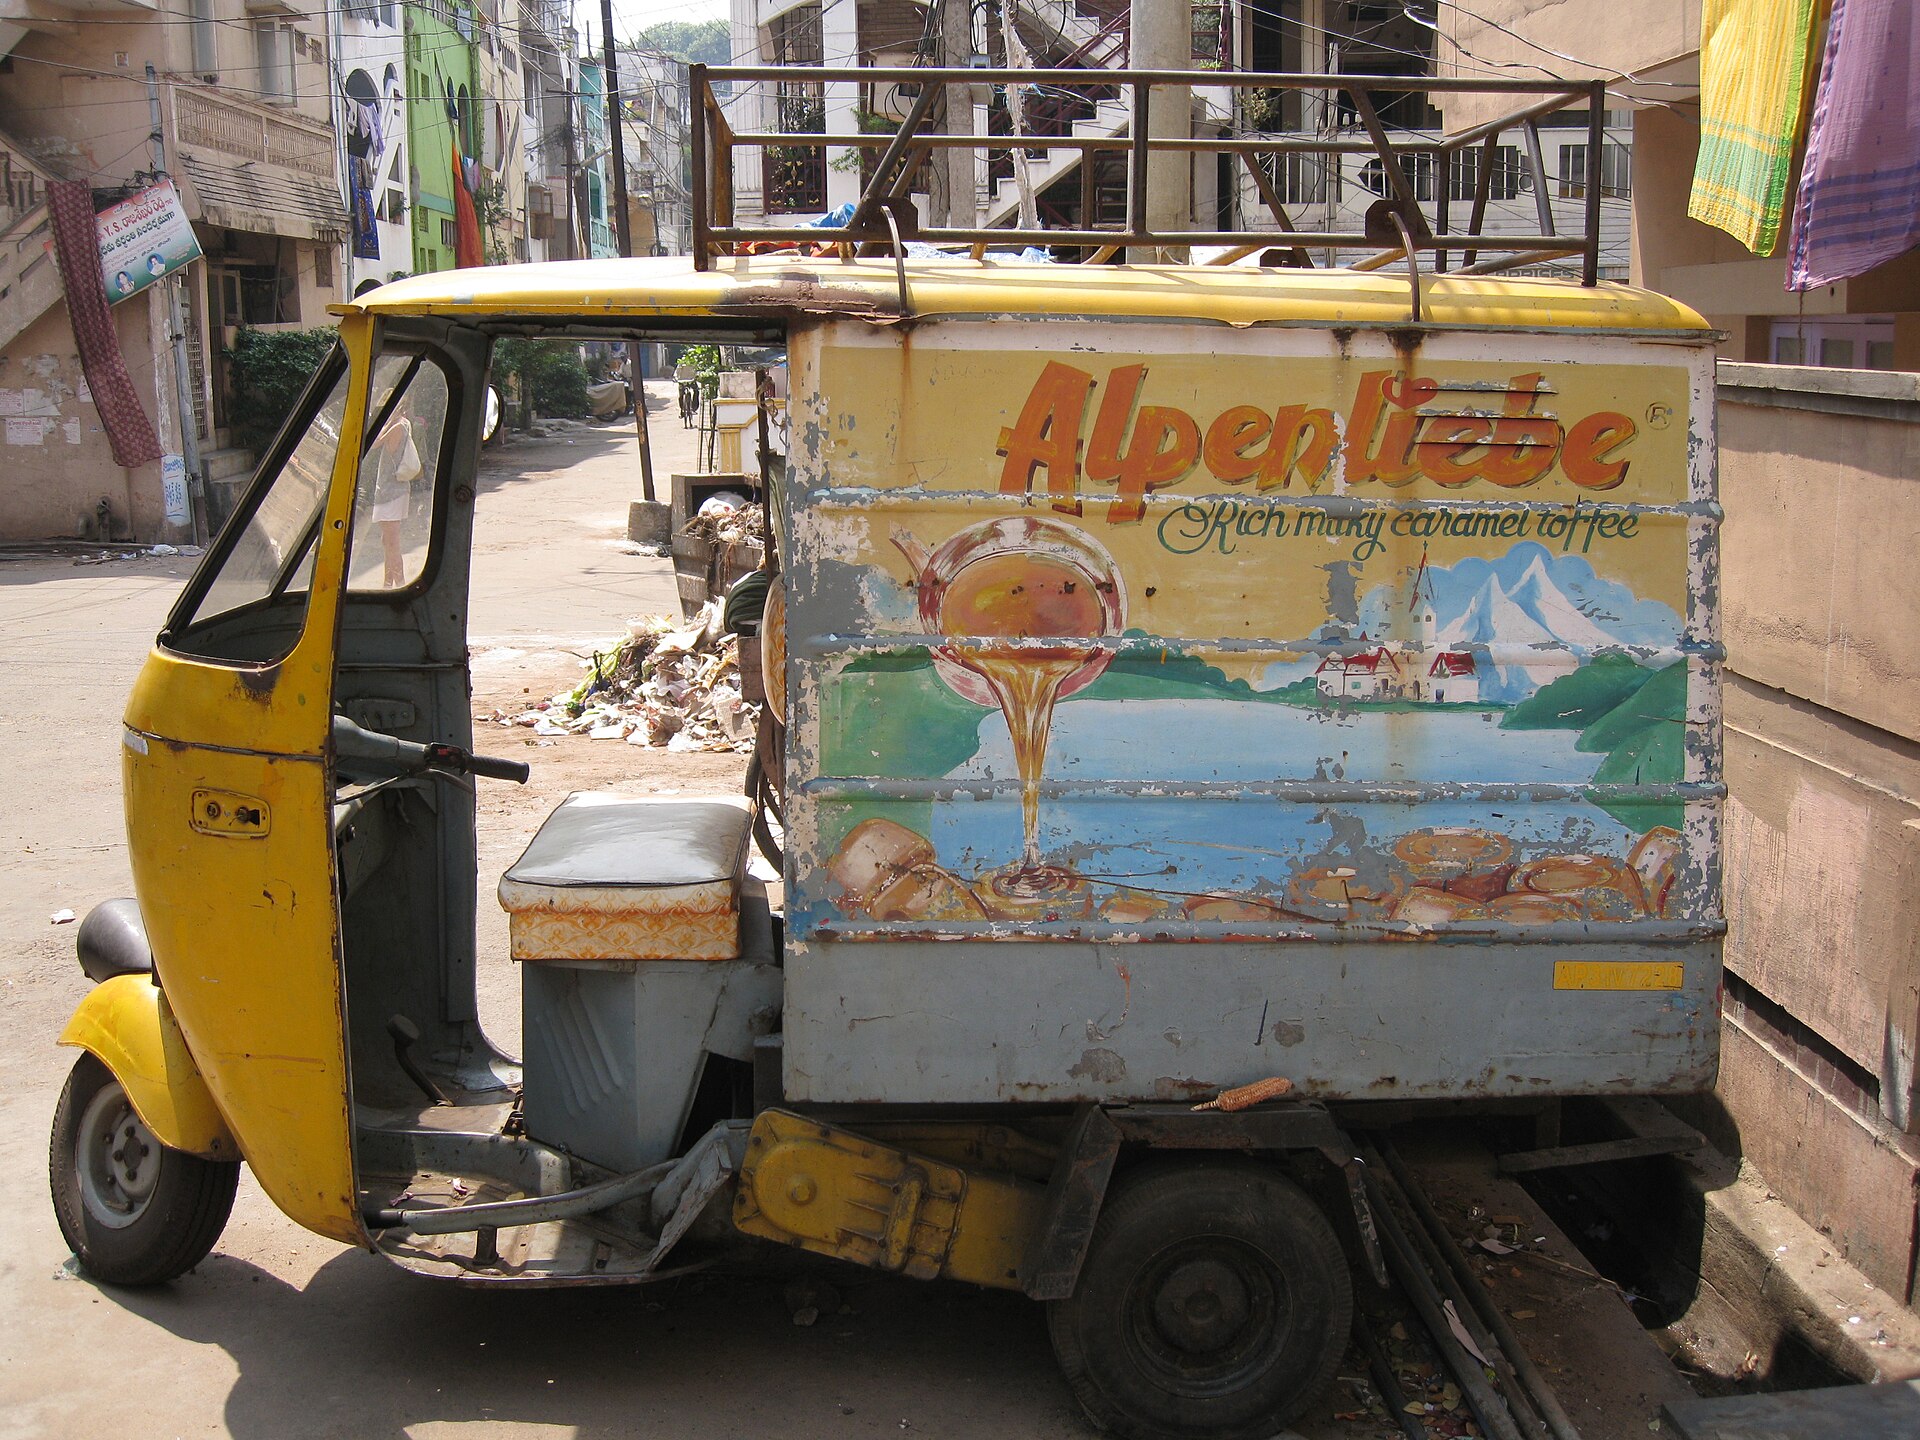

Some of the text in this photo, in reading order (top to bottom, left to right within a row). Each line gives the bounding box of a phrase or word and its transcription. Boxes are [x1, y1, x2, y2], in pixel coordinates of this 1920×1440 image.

[996, 360, 1638, 526] Alpenliebe
[1157, 500, 1291, 554] Rich
[1390, 508, 1531, 538] caramel
